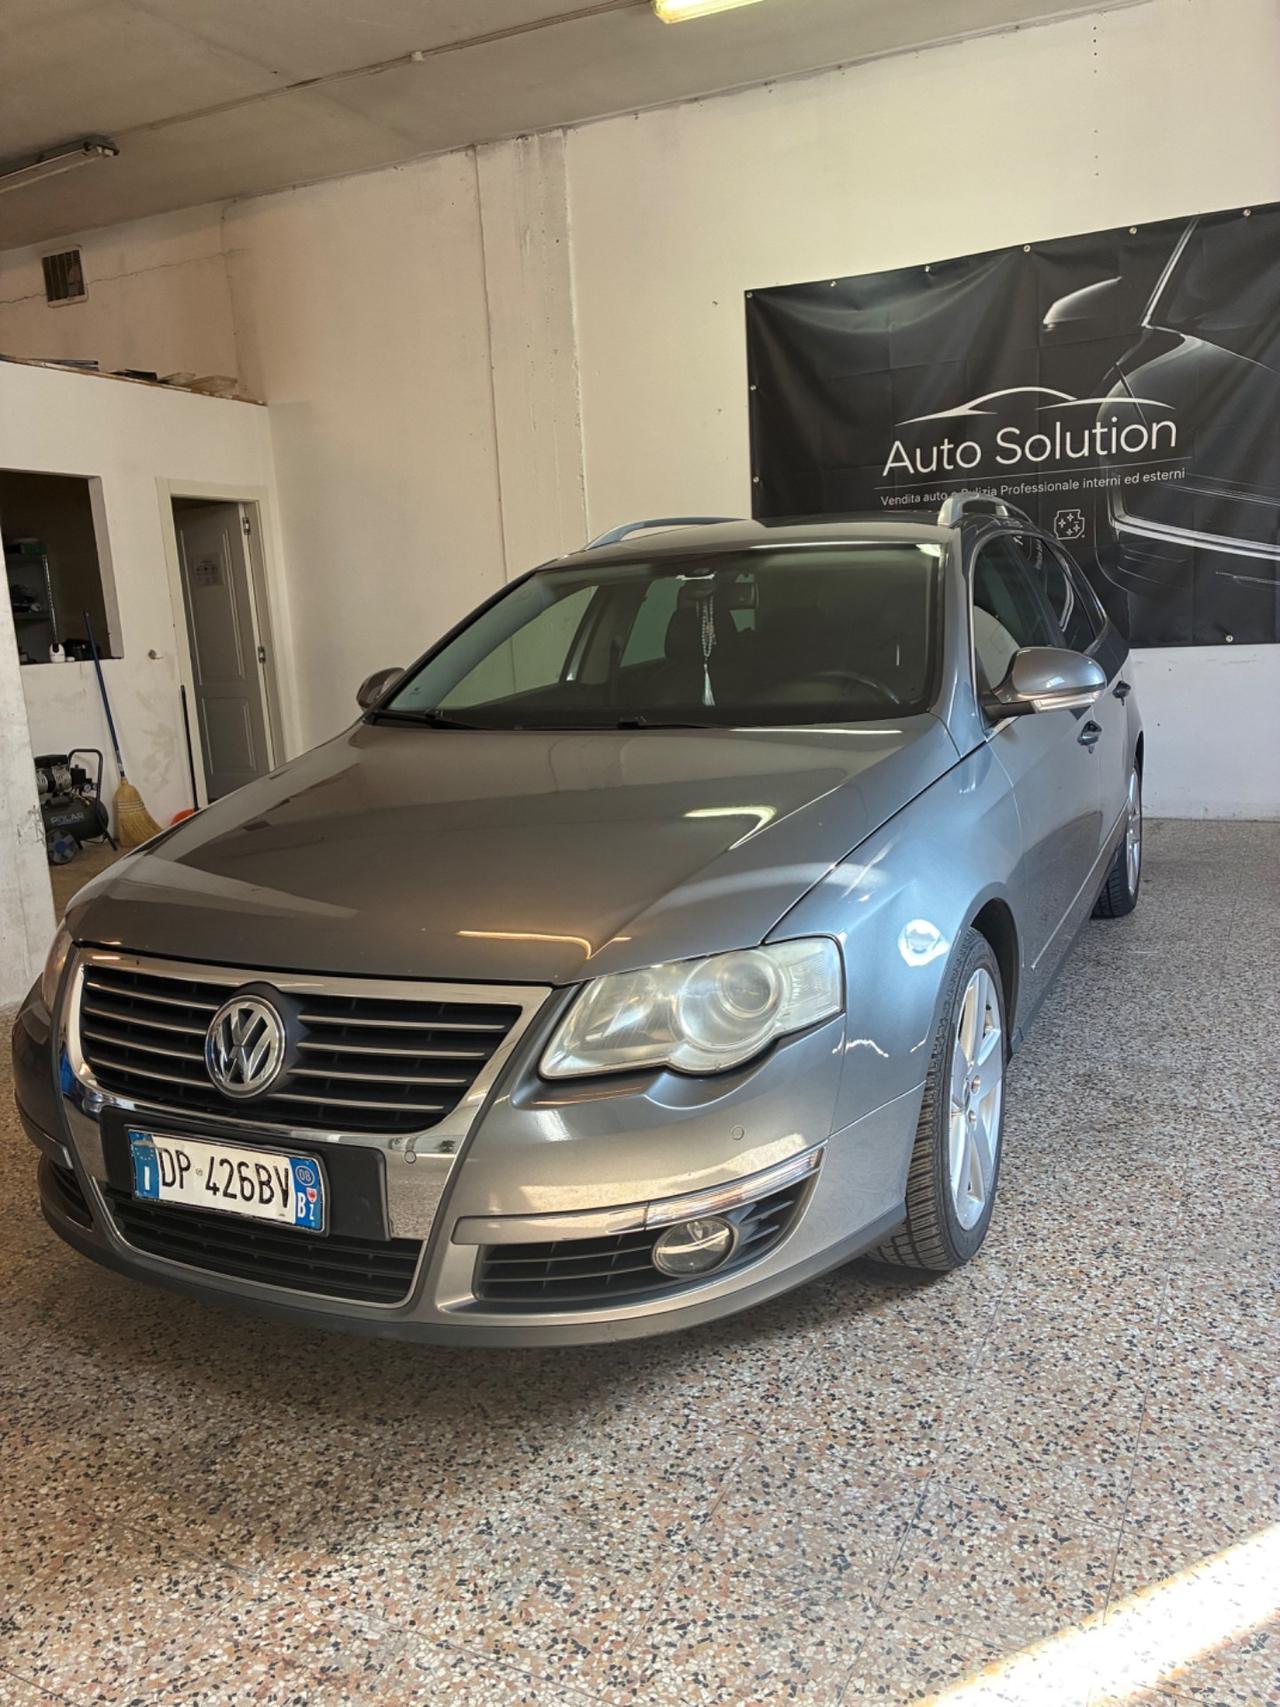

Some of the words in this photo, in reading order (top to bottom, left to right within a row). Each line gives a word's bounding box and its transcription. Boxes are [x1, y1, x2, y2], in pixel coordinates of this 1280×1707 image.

[882, 440, 982, 476] Auto
[995, 416, 1178, 465] Solution
[880, 493, 921, 506] Vendita
[923, 490, 948, 502] auto
[1000, 480, 1080, 496] Professionale
[1083, 474, 1121, 487] interni
[1124, 471, 1140, 484] ed
[1143, 468, 1186, 482] esterni
[143, 1166, 151, 1191] I
[158, 1147, 191, 1190] DP
[205, 1156, 289, 1209] 426BV
